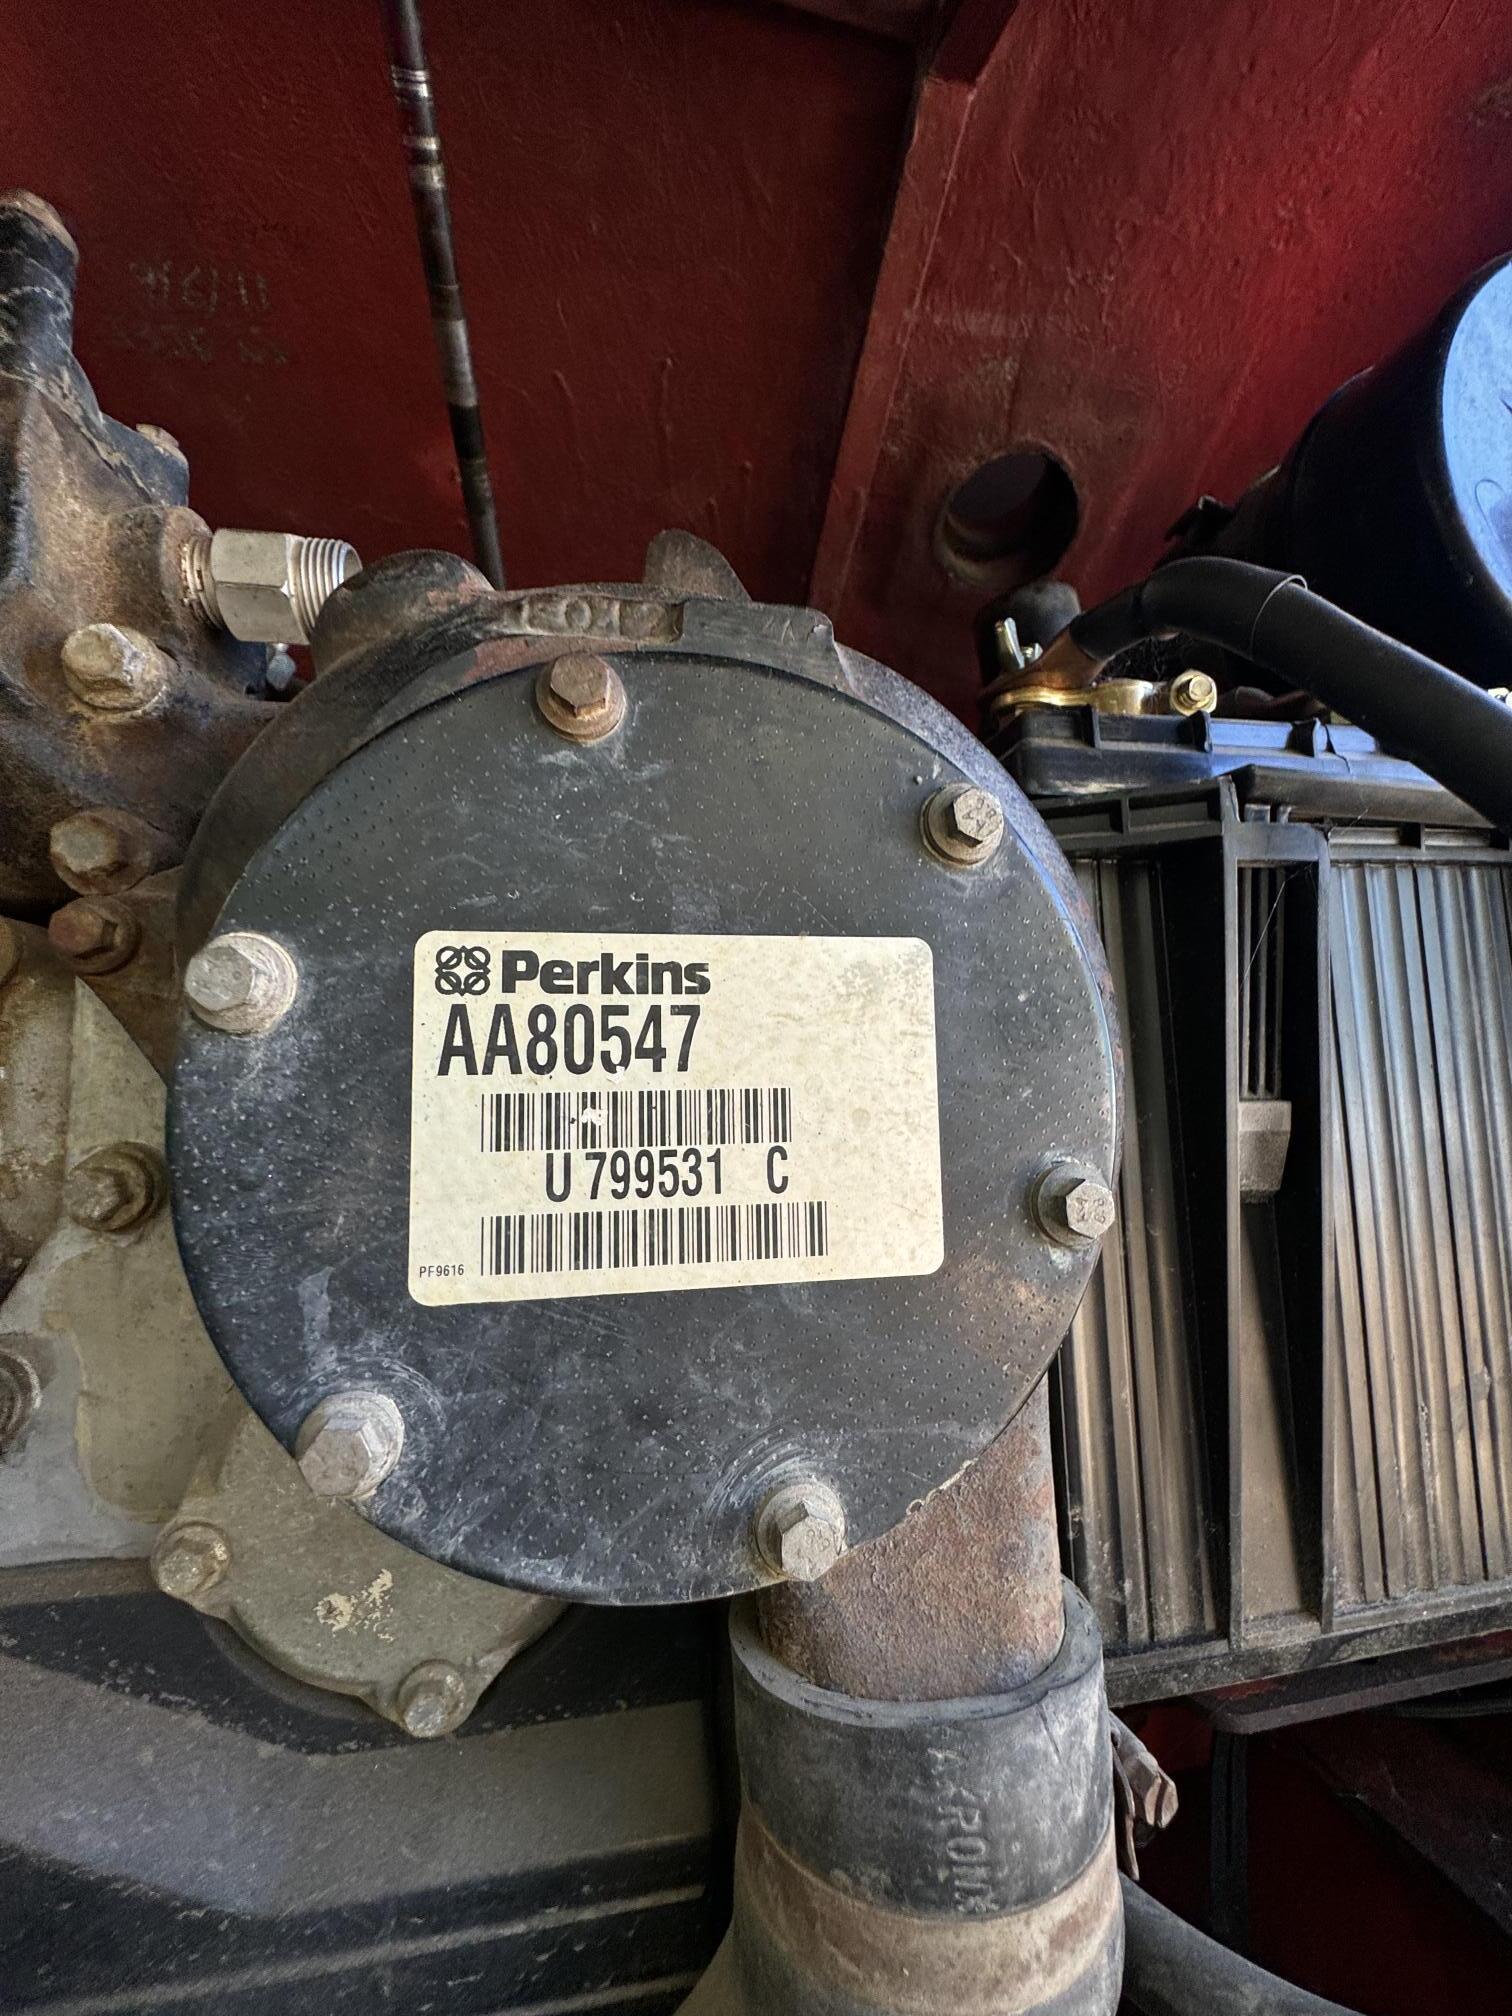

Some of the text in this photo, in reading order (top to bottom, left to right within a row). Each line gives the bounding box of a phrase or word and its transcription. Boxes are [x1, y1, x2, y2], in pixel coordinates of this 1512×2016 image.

[501, 950, 711, 995] Perkins
[437, 1003, 701, 1077] AA80547
[545, 1145, 789, 1203] U 799531 C
[418, 1264, 465, 1278] PF9616
